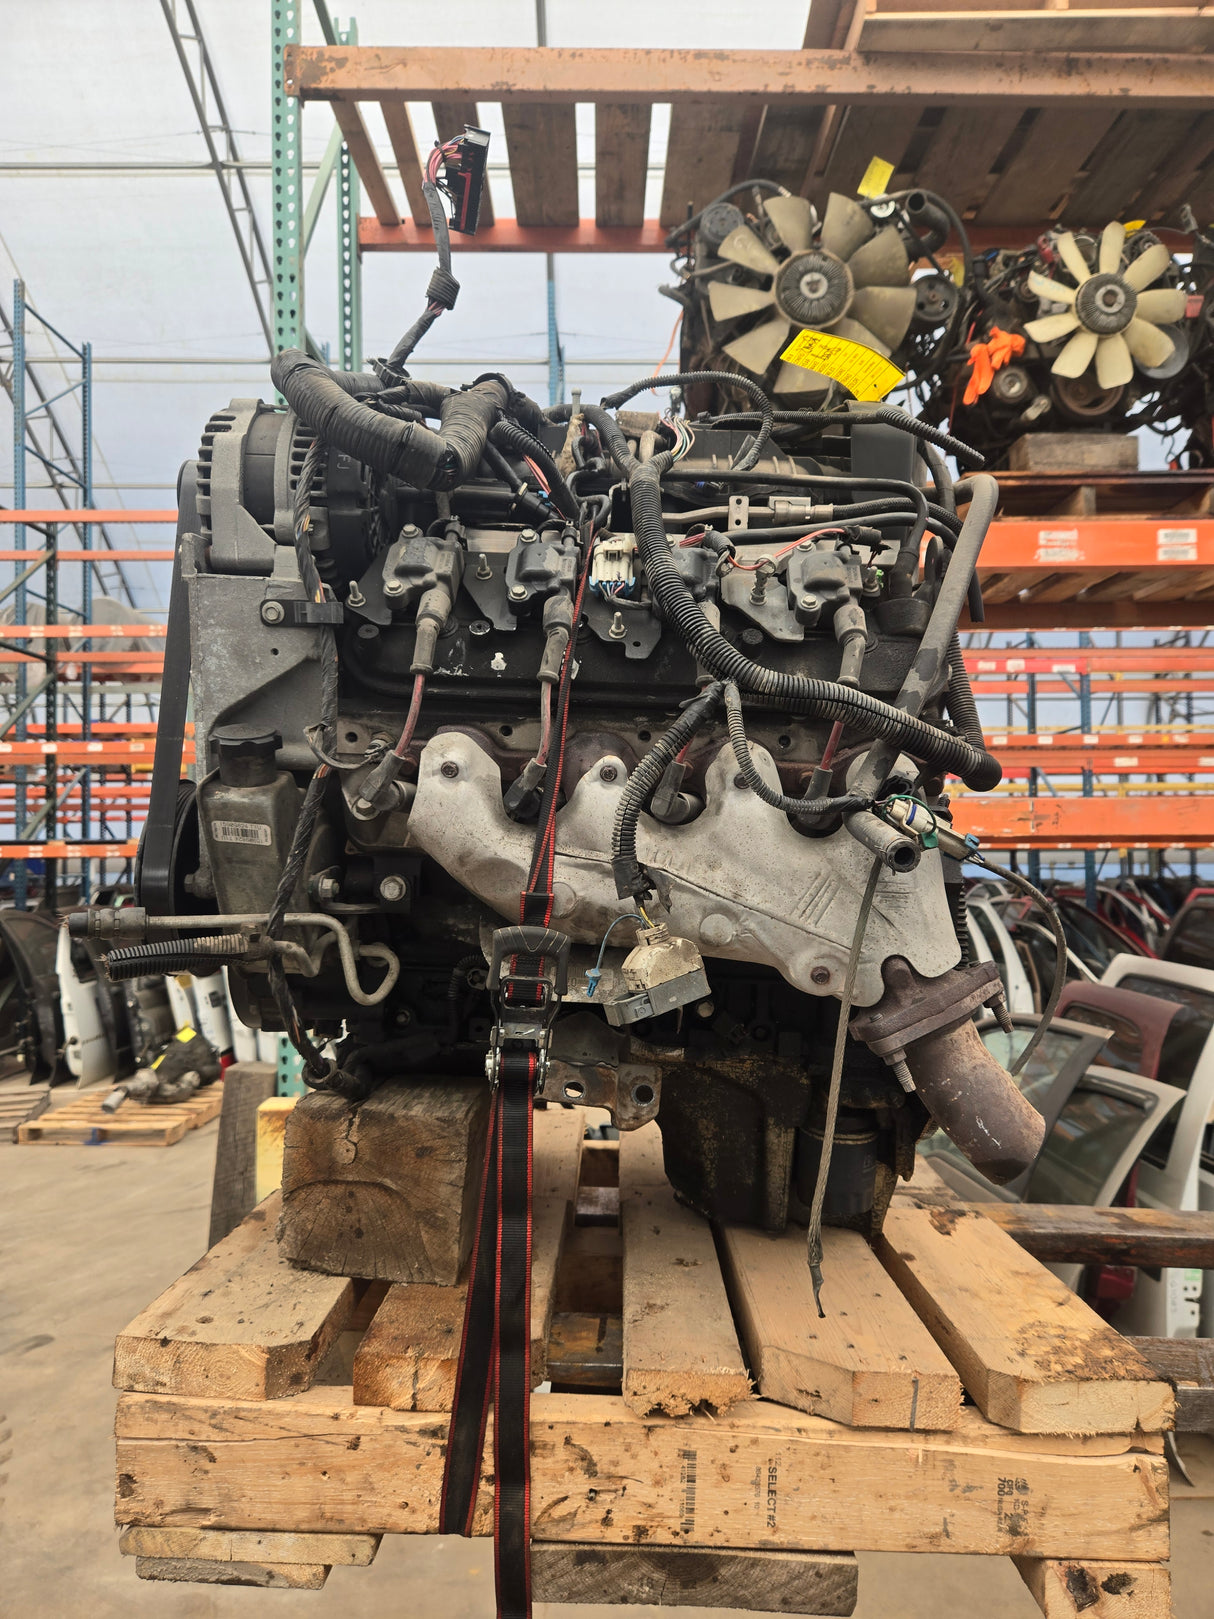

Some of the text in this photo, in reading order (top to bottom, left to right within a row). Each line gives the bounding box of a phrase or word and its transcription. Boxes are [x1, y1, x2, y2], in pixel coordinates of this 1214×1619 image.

[766, 1466, 777, 1528] SELECT #2
[997, 1477, 1006, 1496] 700
